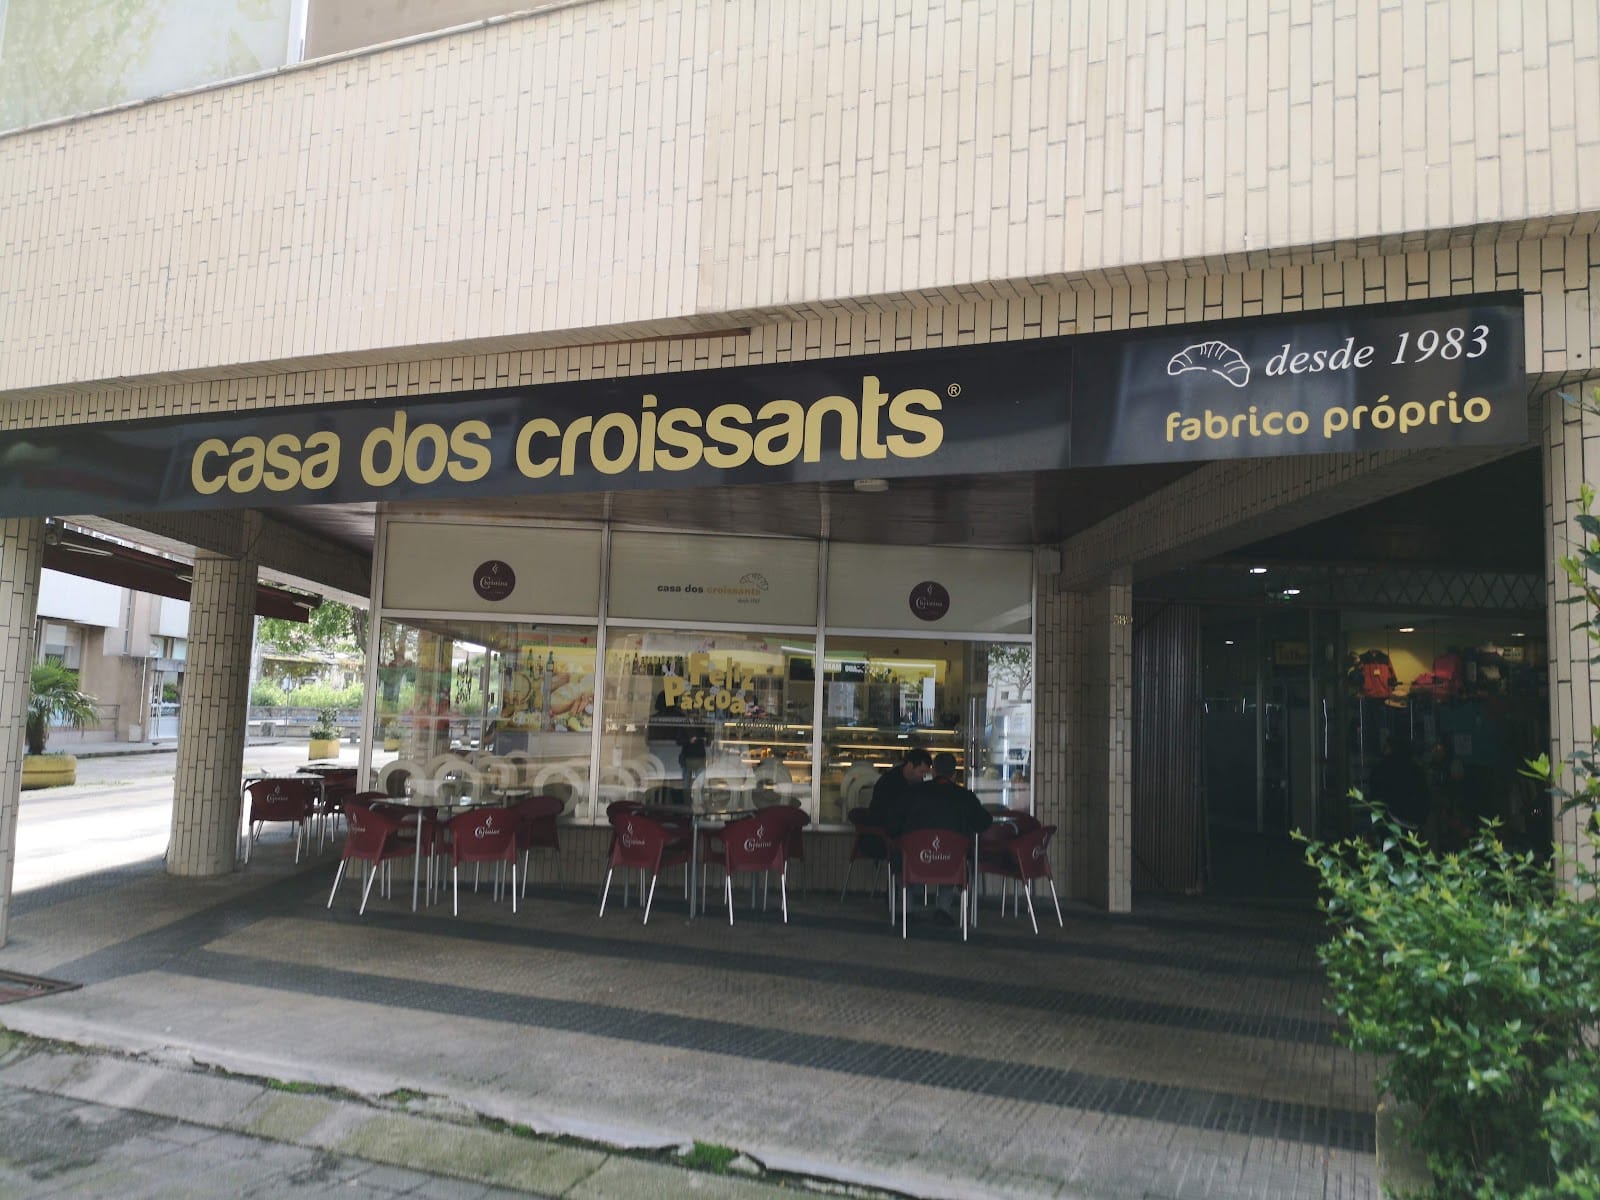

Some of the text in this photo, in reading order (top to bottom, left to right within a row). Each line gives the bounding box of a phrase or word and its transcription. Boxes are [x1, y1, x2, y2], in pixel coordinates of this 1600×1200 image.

[1265, 324, 1490, 377] desde 1983
[191, 375, 944, 495] casa dos croissants
[1166, 391, 1492, 443] fabrico próprio
[657, 585, 681, 593] casa
[684, 584, 704, 594] dos
[690, 653, 755, 691] Feliz
